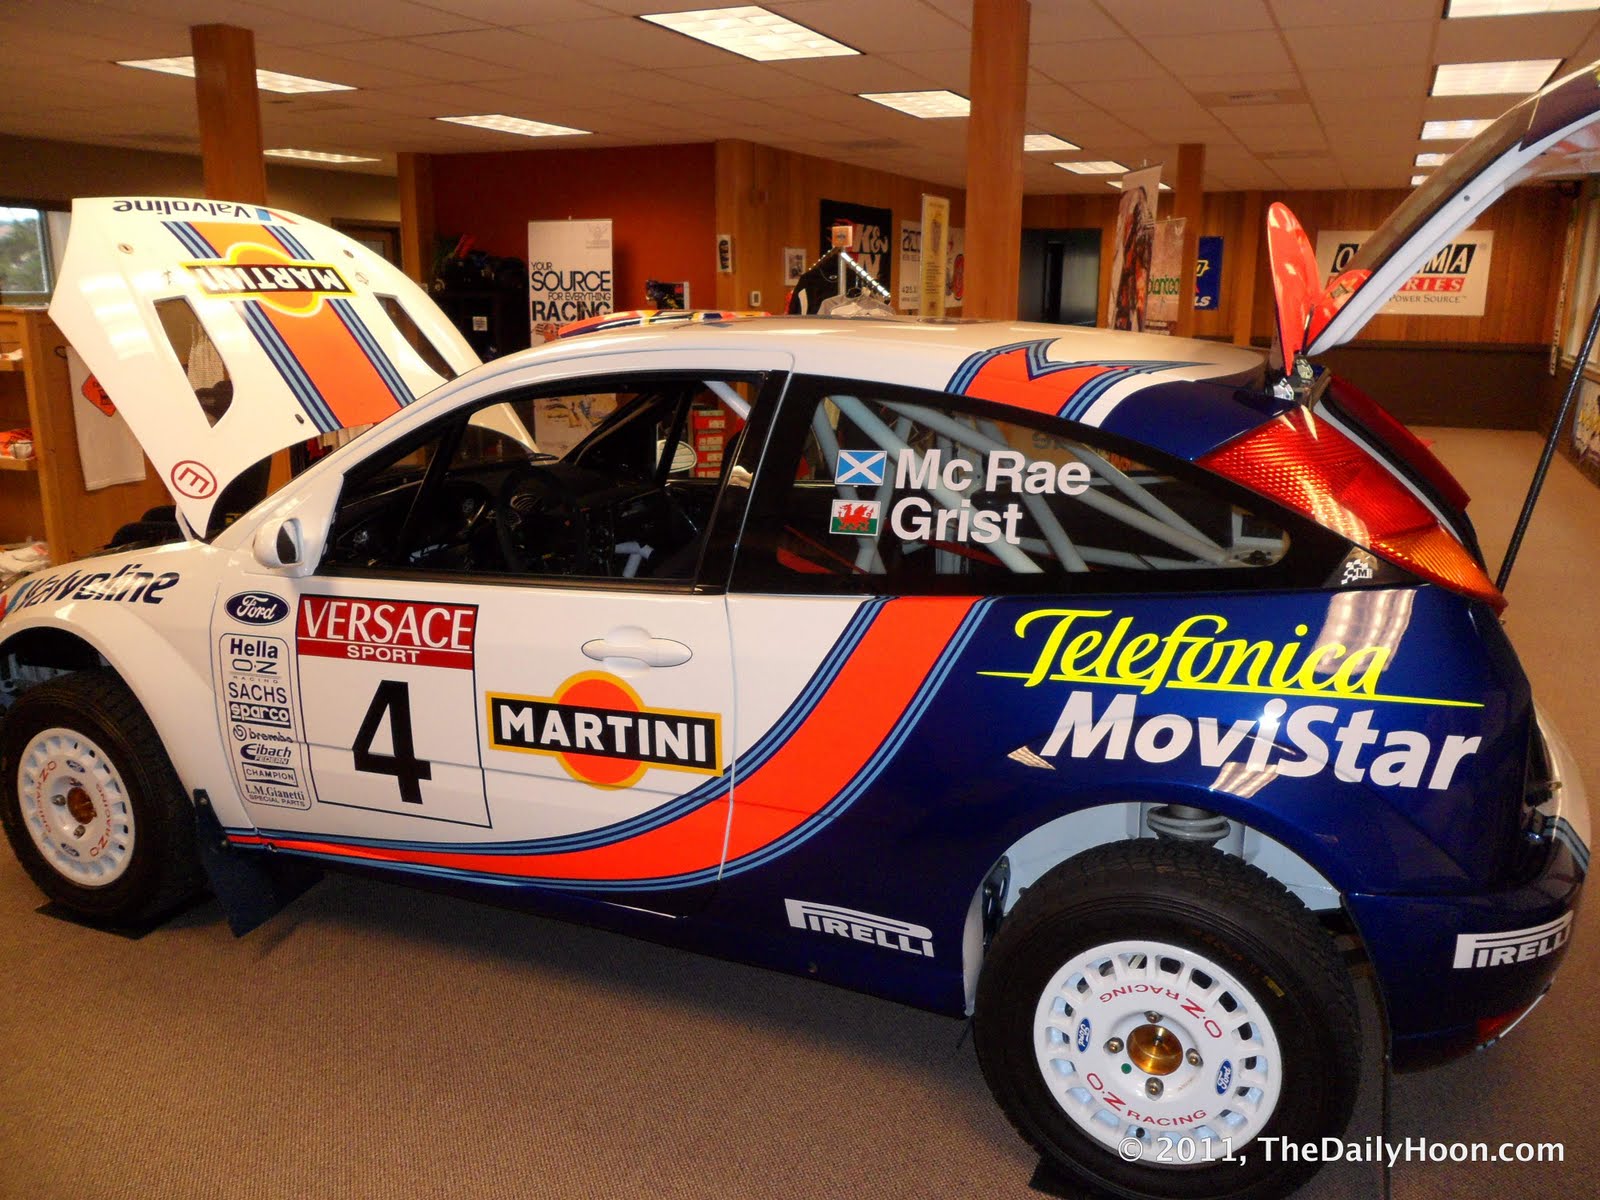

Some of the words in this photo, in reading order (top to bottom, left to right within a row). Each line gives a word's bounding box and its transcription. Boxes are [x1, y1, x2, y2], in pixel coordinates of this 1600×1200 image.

[113, 200, 251, 218] Valvoline
[531, 262, 552, 270] YOUR
[196, 267, 346, 290] MARTINI
[531, 271, 611, 292] SOURCE
[548, 292, 563, 301] FOR
[565, 292, 611, 301] EVERYTHING
[532, 301, 611, 322] RACING
[891, 497, 1023, 544] Grist
[14, 563, 180, 613] Valvoline
[236, 595, 278, 620] Ford
[304, 600, 474, 650] VERSACE
[230, 638, 278, 659] Hella
[347, 645, 420, 663] SPORT
[228, 681, 288, 704] SACHS
[230, 703, 290, 723] sparco
[249, 728, 293, 743] brembo
[352, 680, 432, 804] 4
[500, 705, 706, 762] MARTINI
[1040, 691, 1482, 790] MoviStar
[240, 743, 291, 761] Eibach
[246, 769, 294, 780] CHAMPION
[784, 898, 935, 958] PIRELLI
[1453, 910, 1574, 968] PIRELLI
[1099, 984, 1179, 1003] RACING
[1078, 1022, 1090, 1049] Ford
[1216, 1065, 1232, 1092] Ford
[1127, 1109, 1207, 1126] RACING
